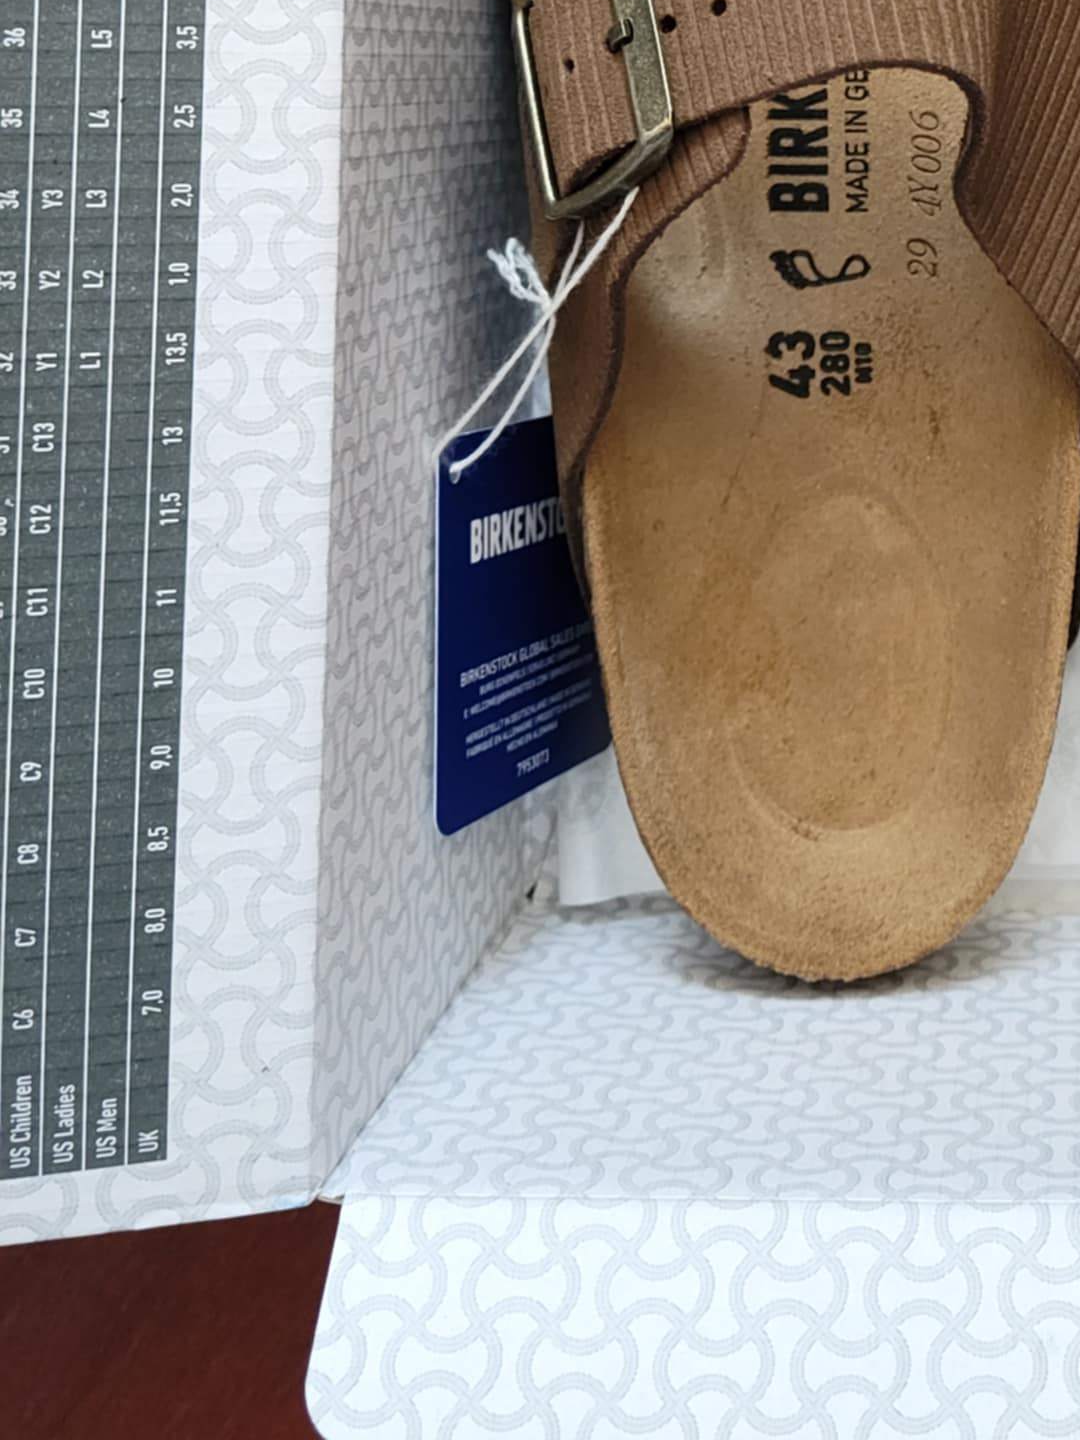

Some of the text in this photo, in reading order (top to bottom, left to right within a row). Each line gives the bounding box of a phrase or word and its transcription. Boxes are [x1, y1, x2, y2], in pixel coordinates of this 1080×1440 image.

[2, 27, 26, 47] 36
[90, 29, 113, 48] L5
[176, 26, 200, 50] 3,5
[0, 108, 23, 128] 35
[88, 109, 110, 128] L4
[174, 105, 197, 128] 2,5
[845, 110, 868, 134] IN
[767, 81, 829, 212] BIRK
[845, 142, 869, 213] MADE
[0, 189, 20, 210] 34
[85, 189, 107, 208] L3
[170, 183, 194, 207] 2,0
[906, 109, 942, 279] 29 4Y006
[82, 270, 104, 288] L2
[168, 262, 191, 285] 1,0
[78, 352, 101, 369] L1
[165, 332, 188, 365] 13,5
[766, 331, 816, 398] 43
[819, 331, 850, 397] 280
[161, 424, 183, 445] 13
[159, 492, 181, 524] 11,5
[155, 589, 177, 607] 11
[9, 189, 64, 1169] US Children C6 C7 C8 C9 C10 C11 C12 C13 Y1 Y2 Y3
[152, 668, 174, 688] 10
[149, 745, 173, 770] 9,0
[147, 826, 170, 852] 8,5
[144, 907, 167, 934] 8,0
[141, 990, 164, 1016] 7,0
[52, 1084, 75, 1138] Ladies
[95, 1098, 117, 1132] Men
[52, 1141, 75, 1163] US
[95, 1135, 117, 1158] US
[137, 1129, 159, 1153] UK
